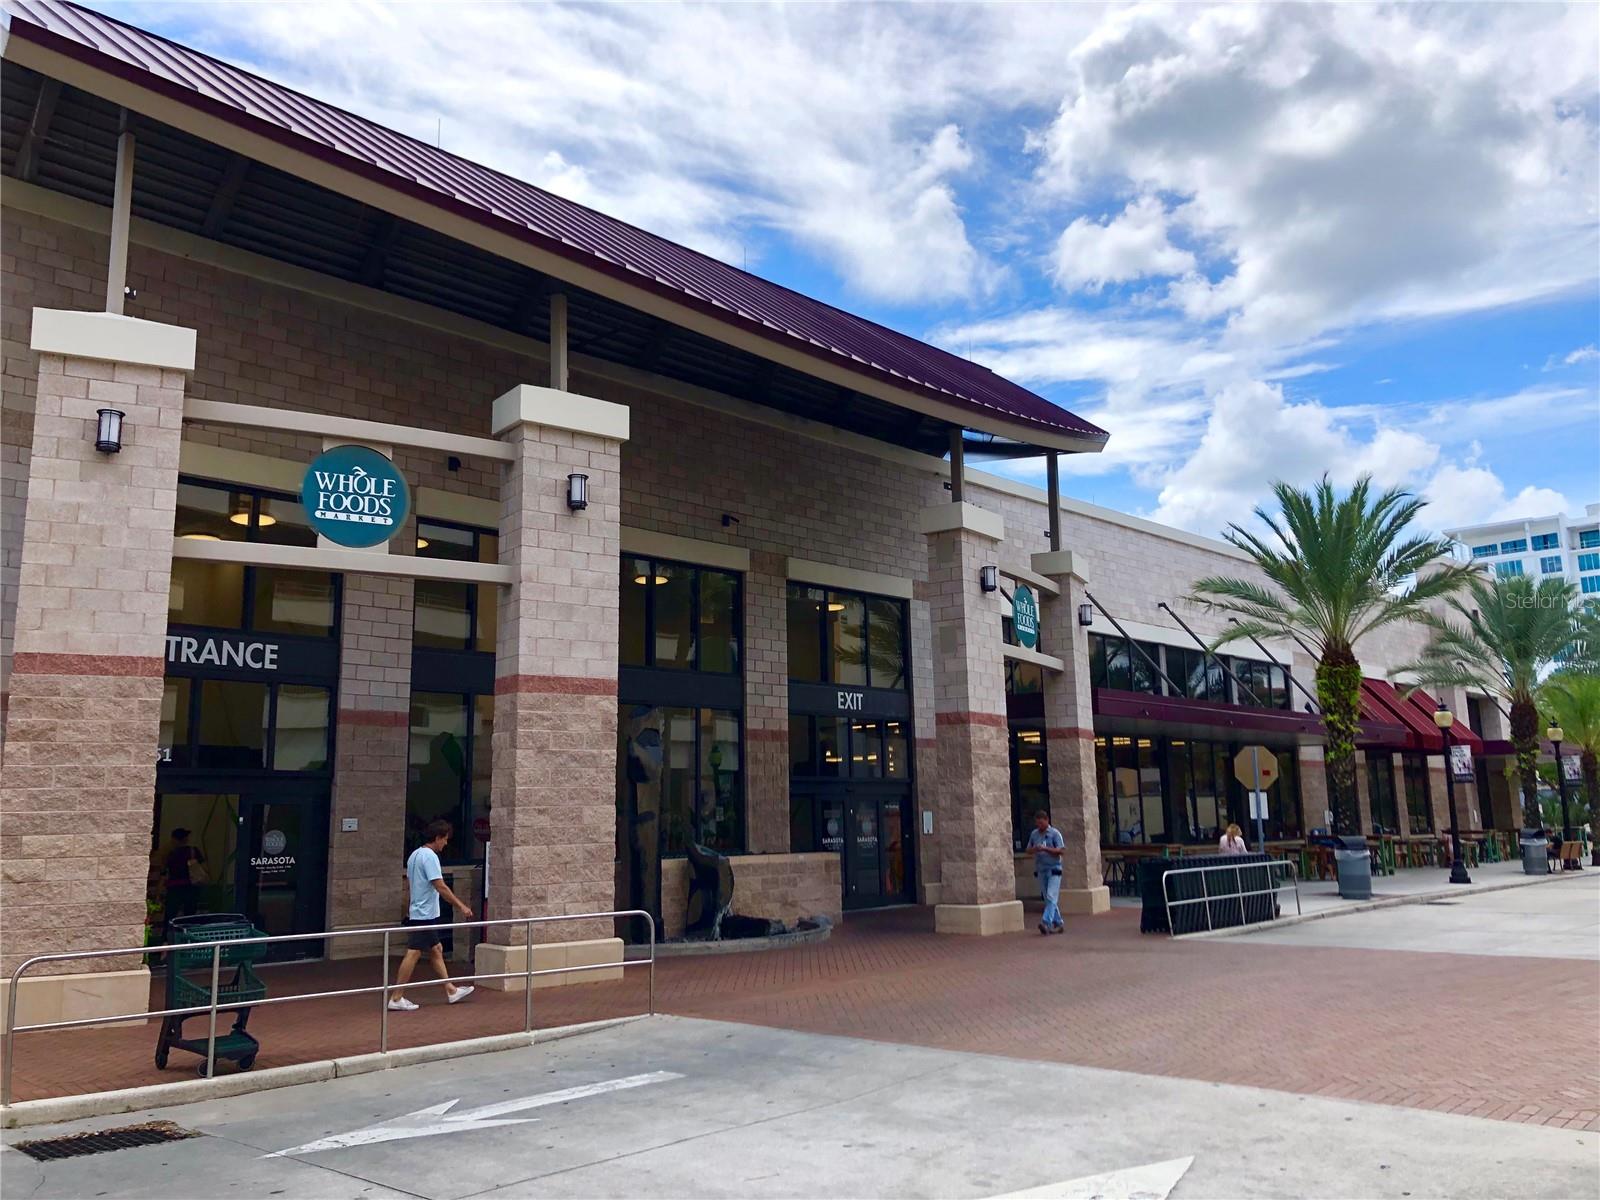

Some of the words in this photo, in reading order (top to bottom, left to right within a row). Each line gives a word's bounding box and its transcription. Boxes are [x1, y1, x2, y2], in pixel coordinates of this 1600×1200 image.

[314, 466, 396, 497] WHOLE
[318, 491, 392, 516] FOODS
[318, 511, 390, 524] MARKET
[1015, 598, 1034, 617] WHOLE
[1017, 613, 1034, 629] FOODS
[837, 691, 863, 711] EXIT
[250, 856, 296, 866] SARASOTA
